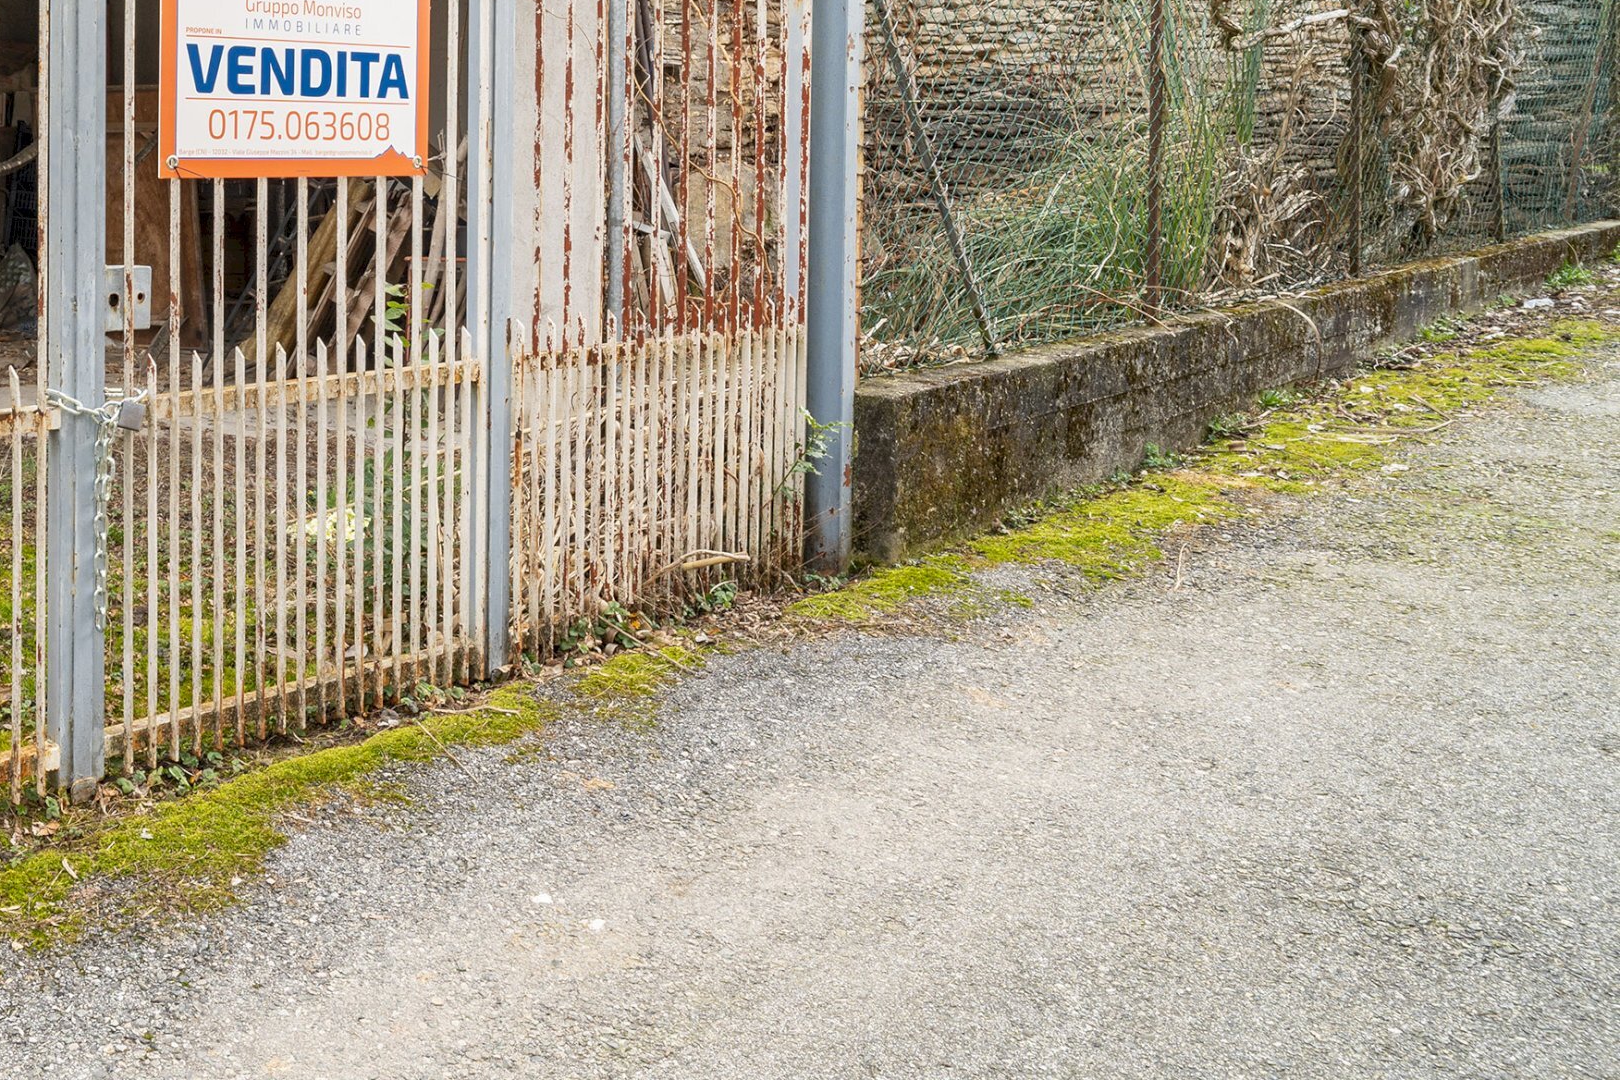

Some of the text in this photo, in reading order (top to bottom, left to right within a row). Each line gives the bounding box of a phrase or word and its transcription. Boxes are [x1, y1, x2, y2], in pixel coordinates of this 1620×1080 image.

[303, 0, 362, 19] Monviso
[245, 18, 362, 36] IMMOBILIARE
[186, 43, 409, 100] VENDITA
[208, 109, 390, 141] 0175.063608
[178, 148, 195, 156] Barge
[212, 148, 228, 156] 12032
